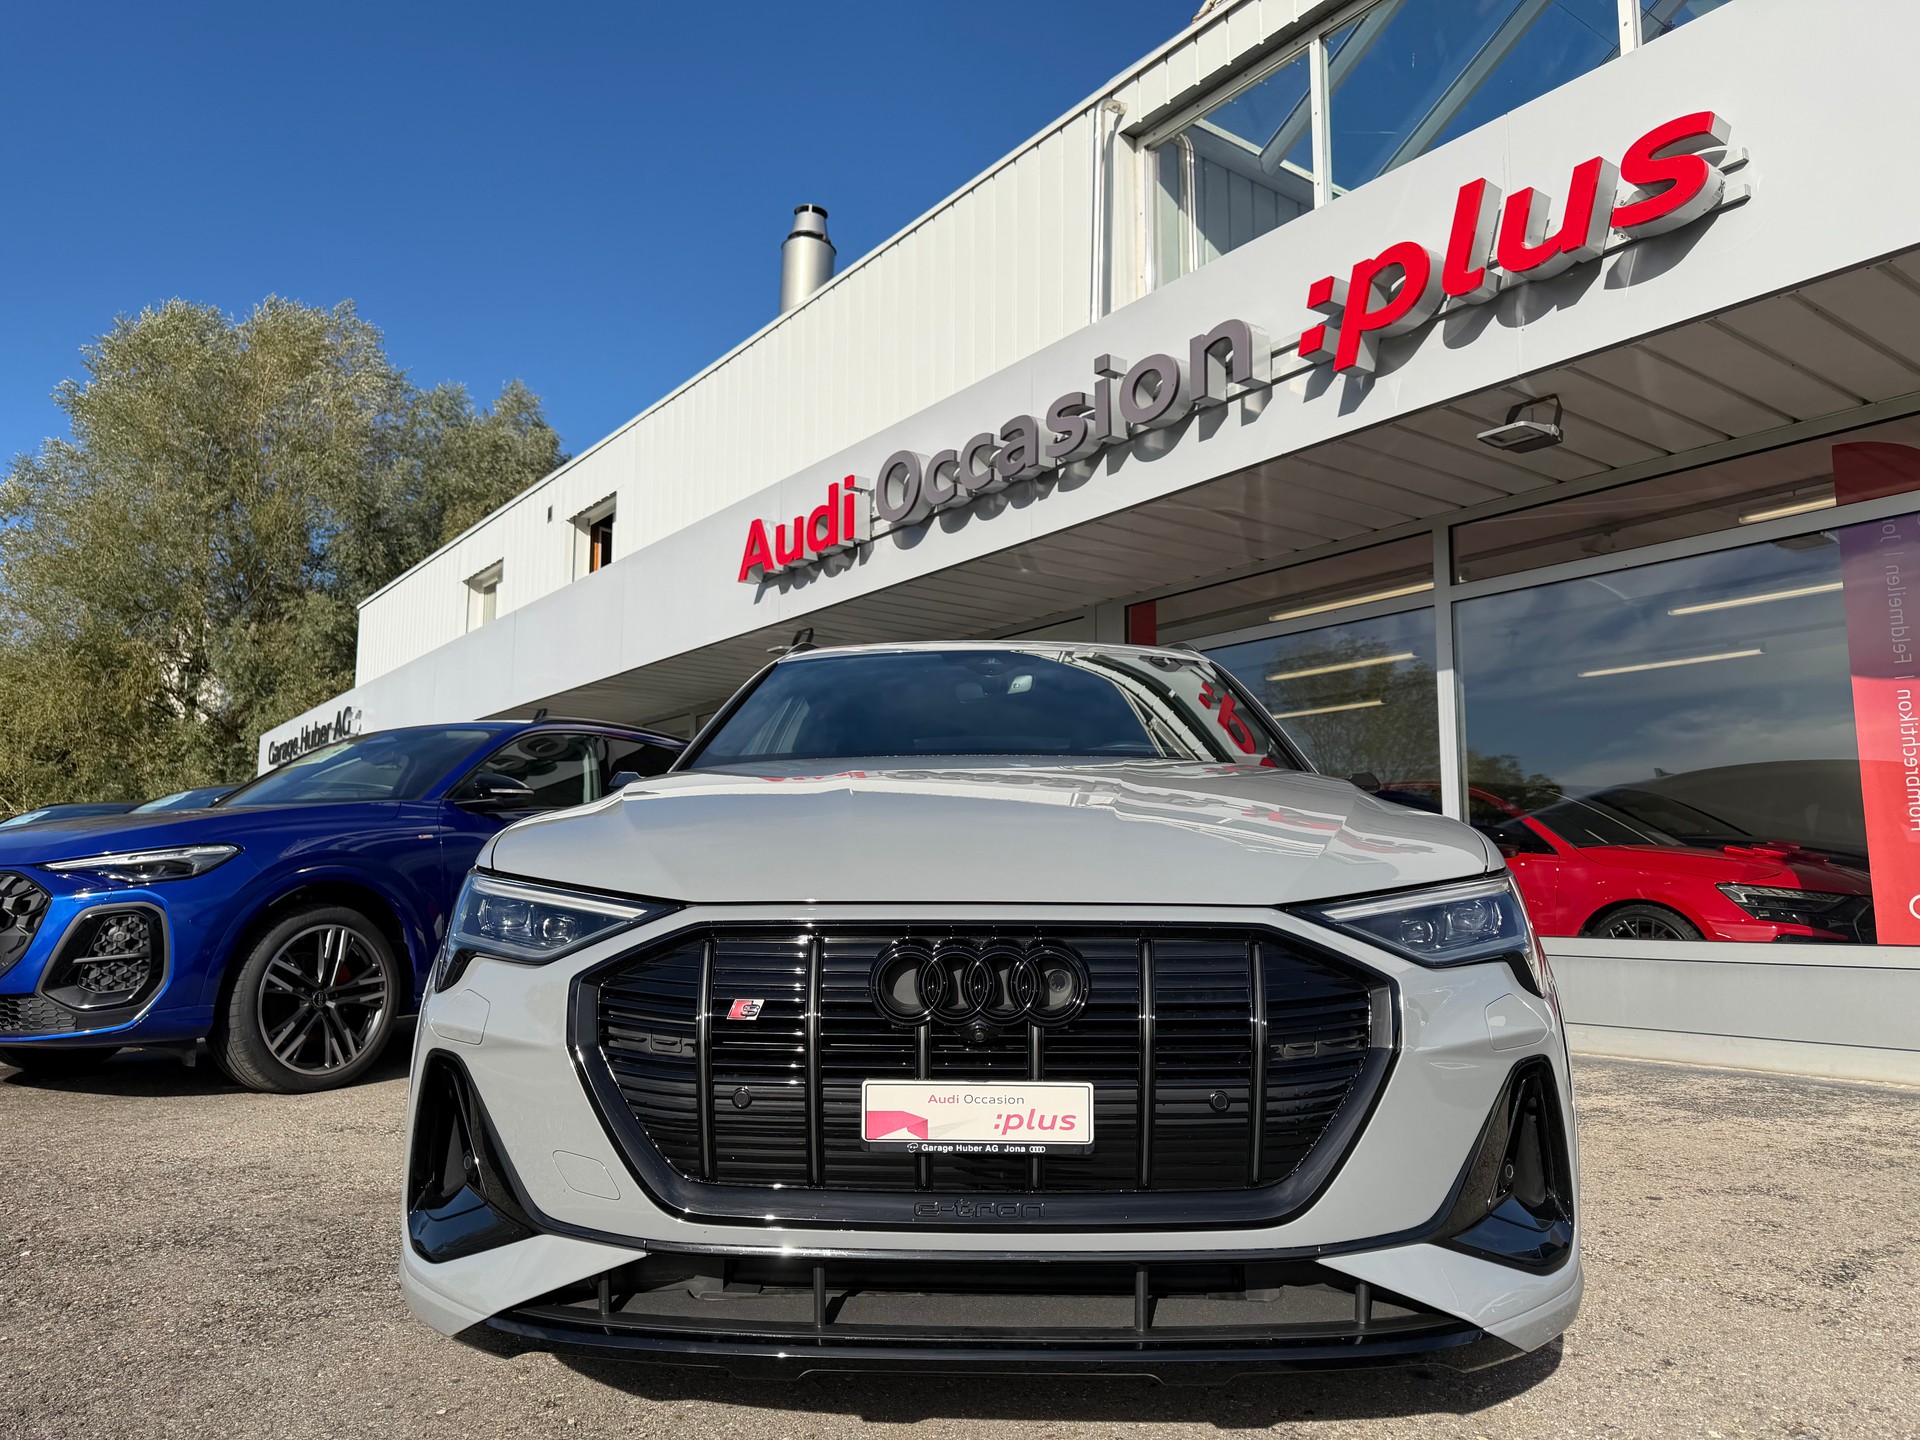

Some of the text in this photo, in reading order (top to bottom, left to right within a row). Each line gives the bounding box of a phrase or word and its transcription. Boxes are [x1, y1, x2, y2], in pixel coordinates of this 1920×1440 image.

[738, 110, 1714, 582] Audi Occasion :plus
[268, 706, 353, 766] Garage Huber AG
[927, 1094, 1025, 1105] Audi Occasion
[993, 1108, 1077, 1136] :plus
[921, 1144, 954, 1153] Garage
[955, 1144, 983, 1152] Huber
[914, 1199, 1046, 1218] e-tron
